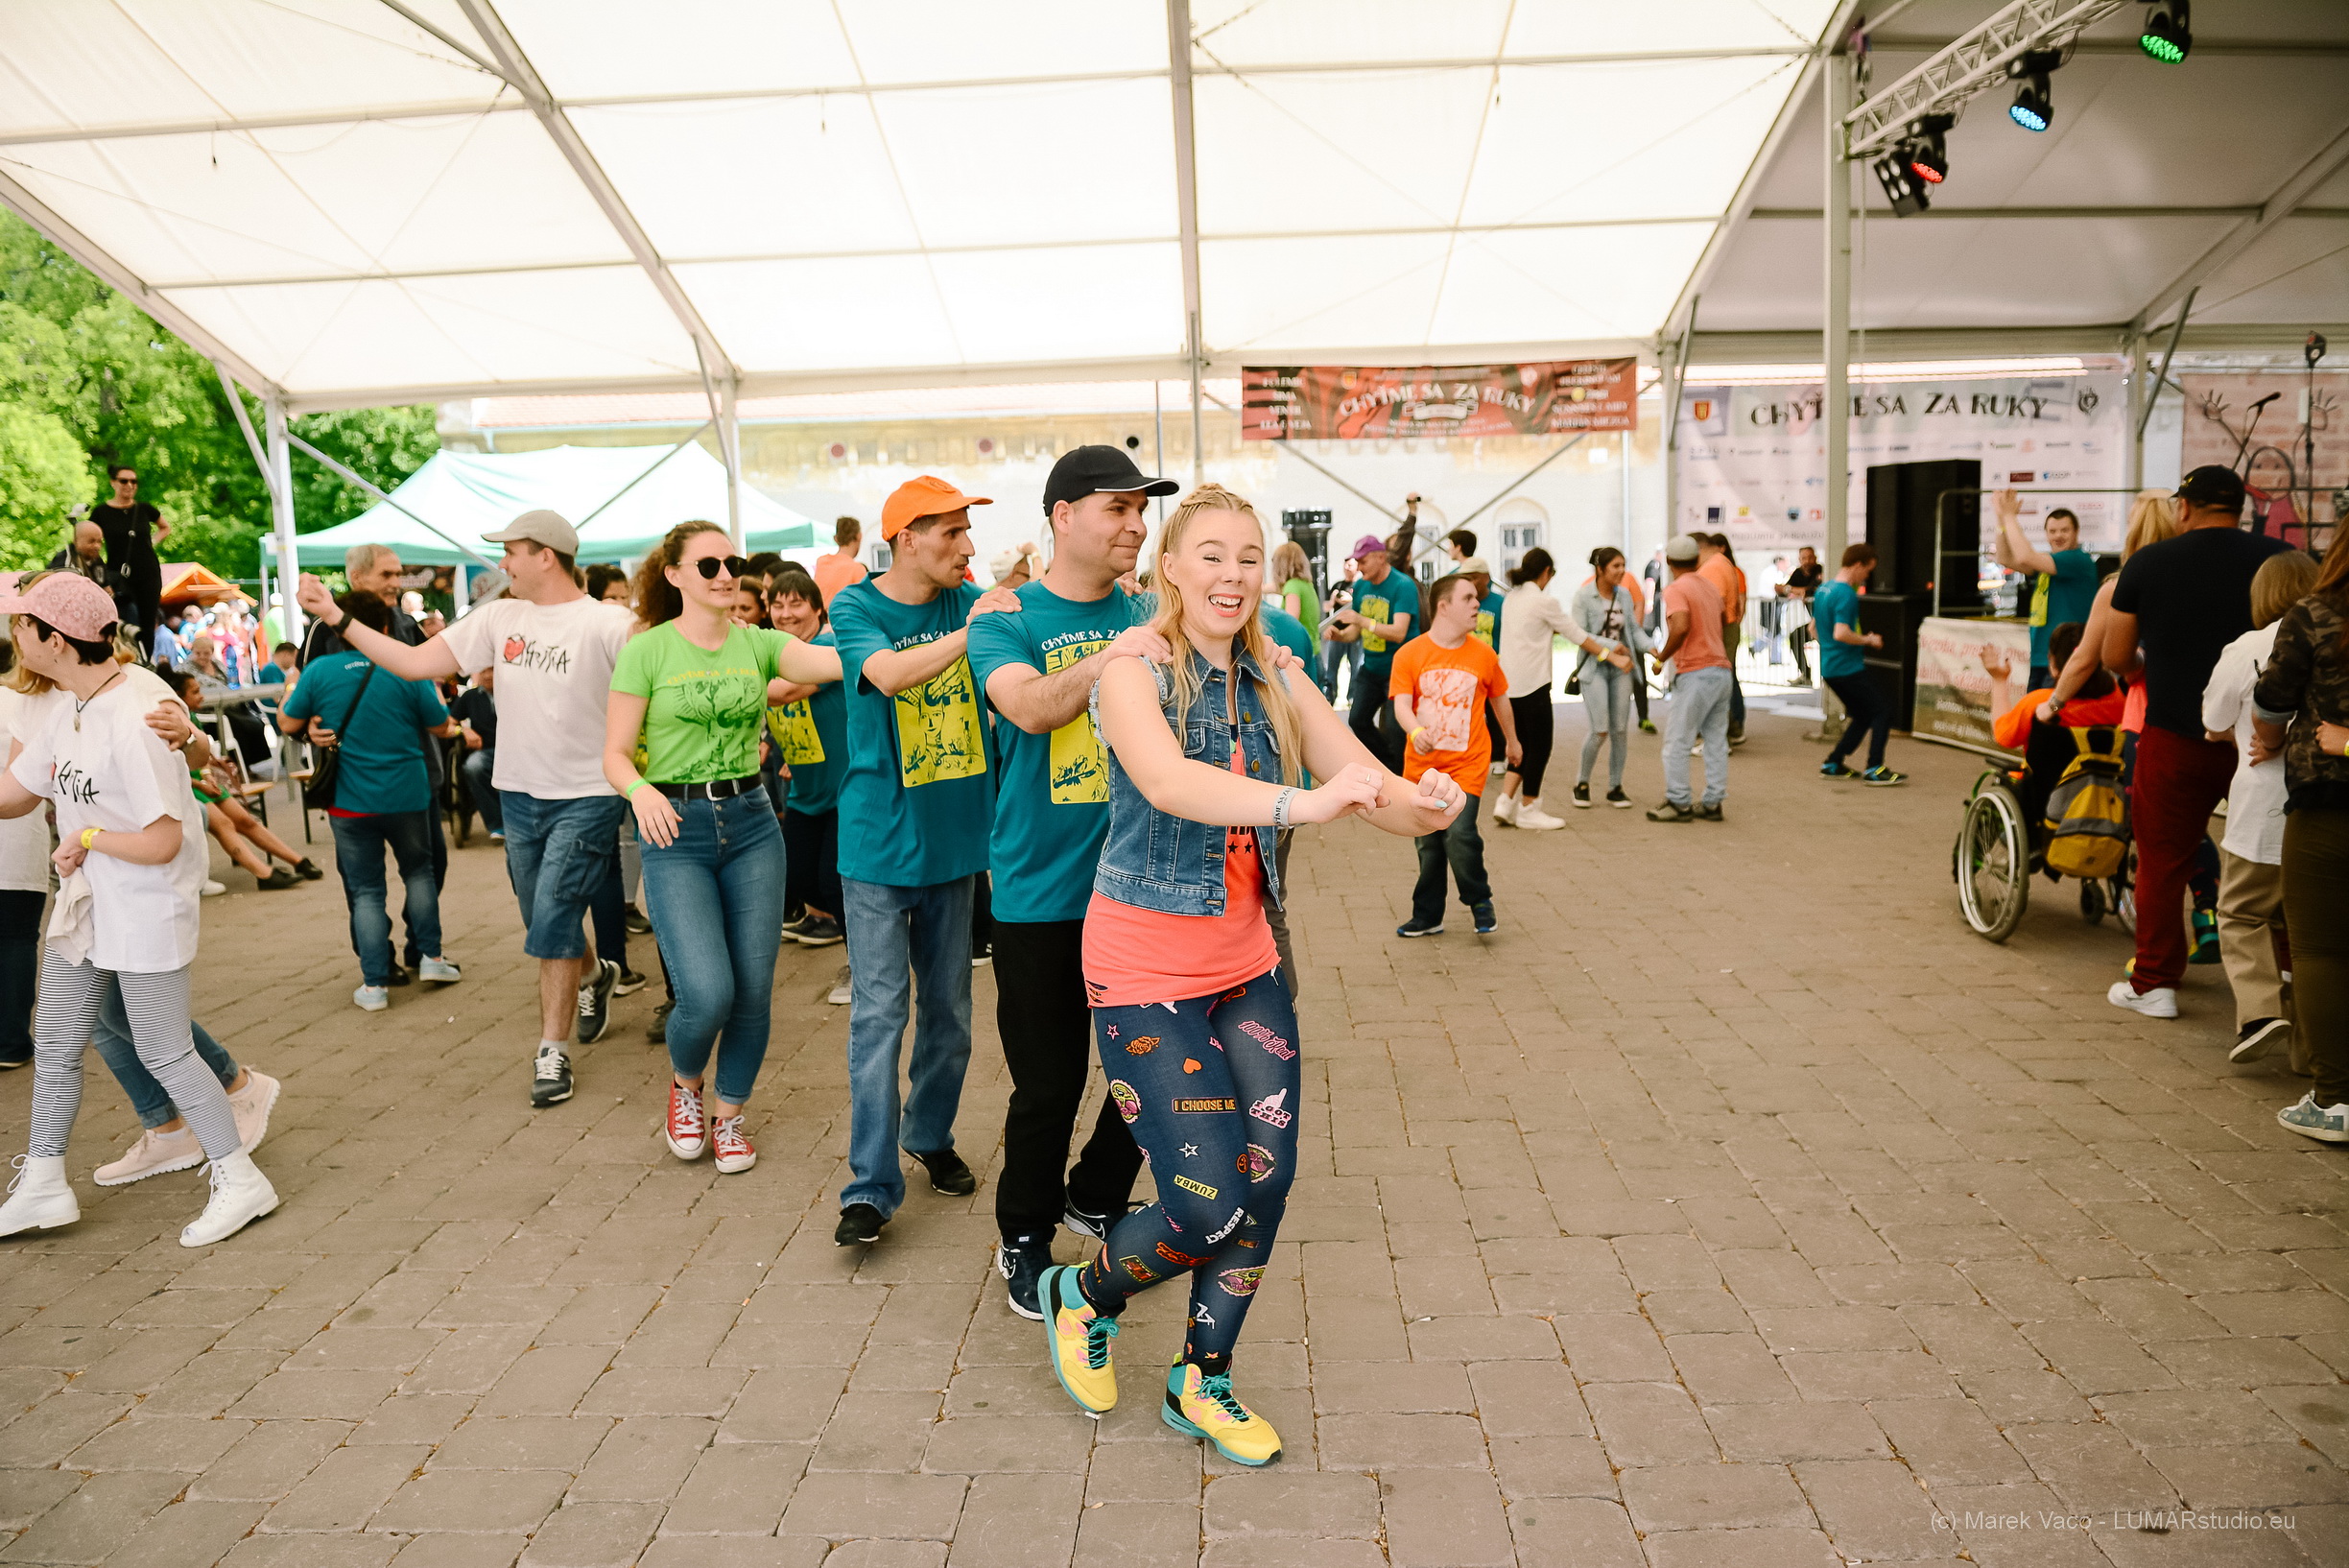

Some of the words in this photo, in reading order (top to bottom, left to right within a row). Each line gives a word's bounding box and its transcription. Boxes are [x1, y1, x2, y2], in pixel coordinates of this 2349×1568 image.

[1421, 383, 1444, 400] SA
[1454, 383, 1479, 400] ZA
[1483, 385, 1535, 414] RUKY
[1751, 392, 1867, 426] CHYŤE
[1876, 392, 1907, 416] SA
[1924, 392, 1960, 416] ZA
[1971, 392, 2049, 419] RUKY
[920, 632, 933, 642] SA
[1041, 631, 1086, 651] CHYŤME
[1088, 630, 1103, 640] SA
[1174, 1101, 1179, 1111] I
[1181, 1100, 1223, 1111] CHOOSE
[1224, 1099, 1236, 1110] ME
[1265, 1105, 1291, 1119] GOT
[1250, 1107, 1286, 1127] THIS
[1175, 1176, 1216, 1199] ZUMBA
[1205, 1207, 1245, 1245] RESPECT
